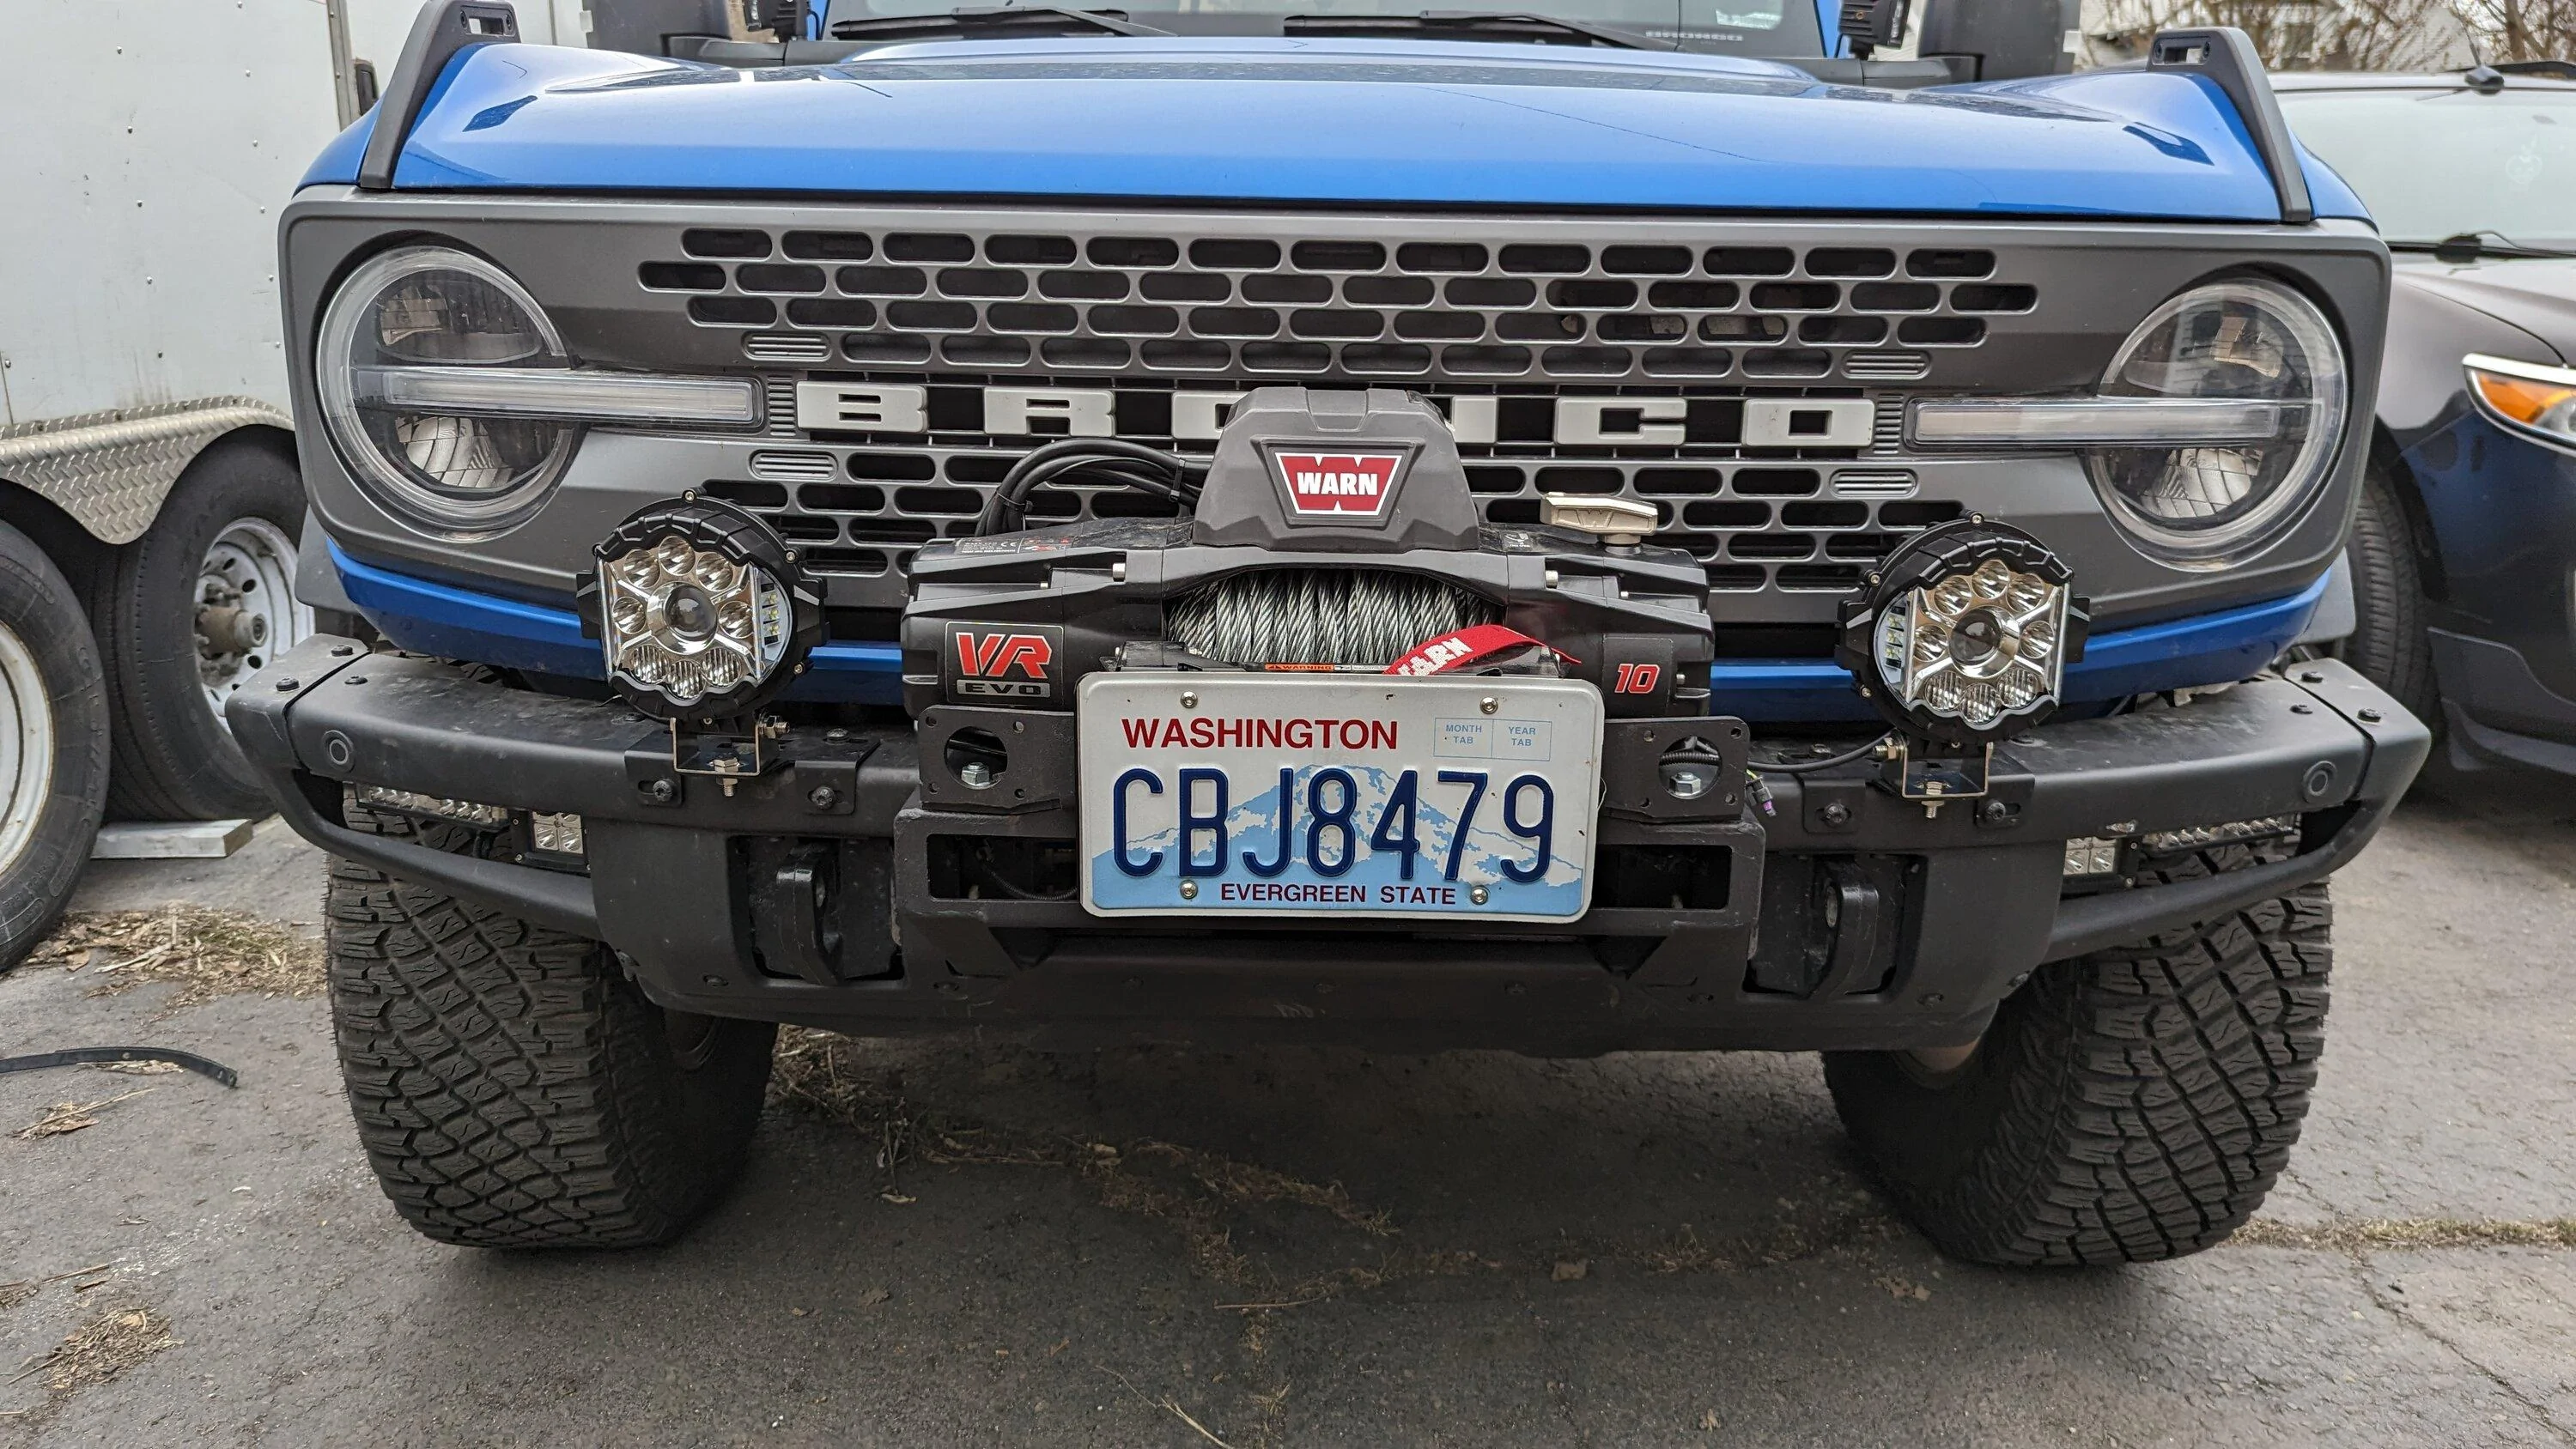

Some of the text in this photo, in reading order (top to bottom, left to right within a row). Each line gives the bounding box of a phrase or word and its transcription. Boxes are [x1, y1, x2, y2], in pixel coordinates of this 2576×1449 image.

[1297, 471, 1378, 495] WARN
[956, 632, 1052, 679] VR
[964, 682, 1042, 694] EVO
[1614, 664, 1660, 694] 10
[1121, 718, 1398, 749] WASHINGTON
[1445, 724, 1482, 733] MONTH
[1508, 726, 1536, 736] YEAR
[1453, 736, 1473, 744] TAB
[1511, 737, 1532, 746] TAB
[1113, 767, 1554, 883] CBJ8479
[1220, 883, 1456, 905] EVERGREEN STATE
